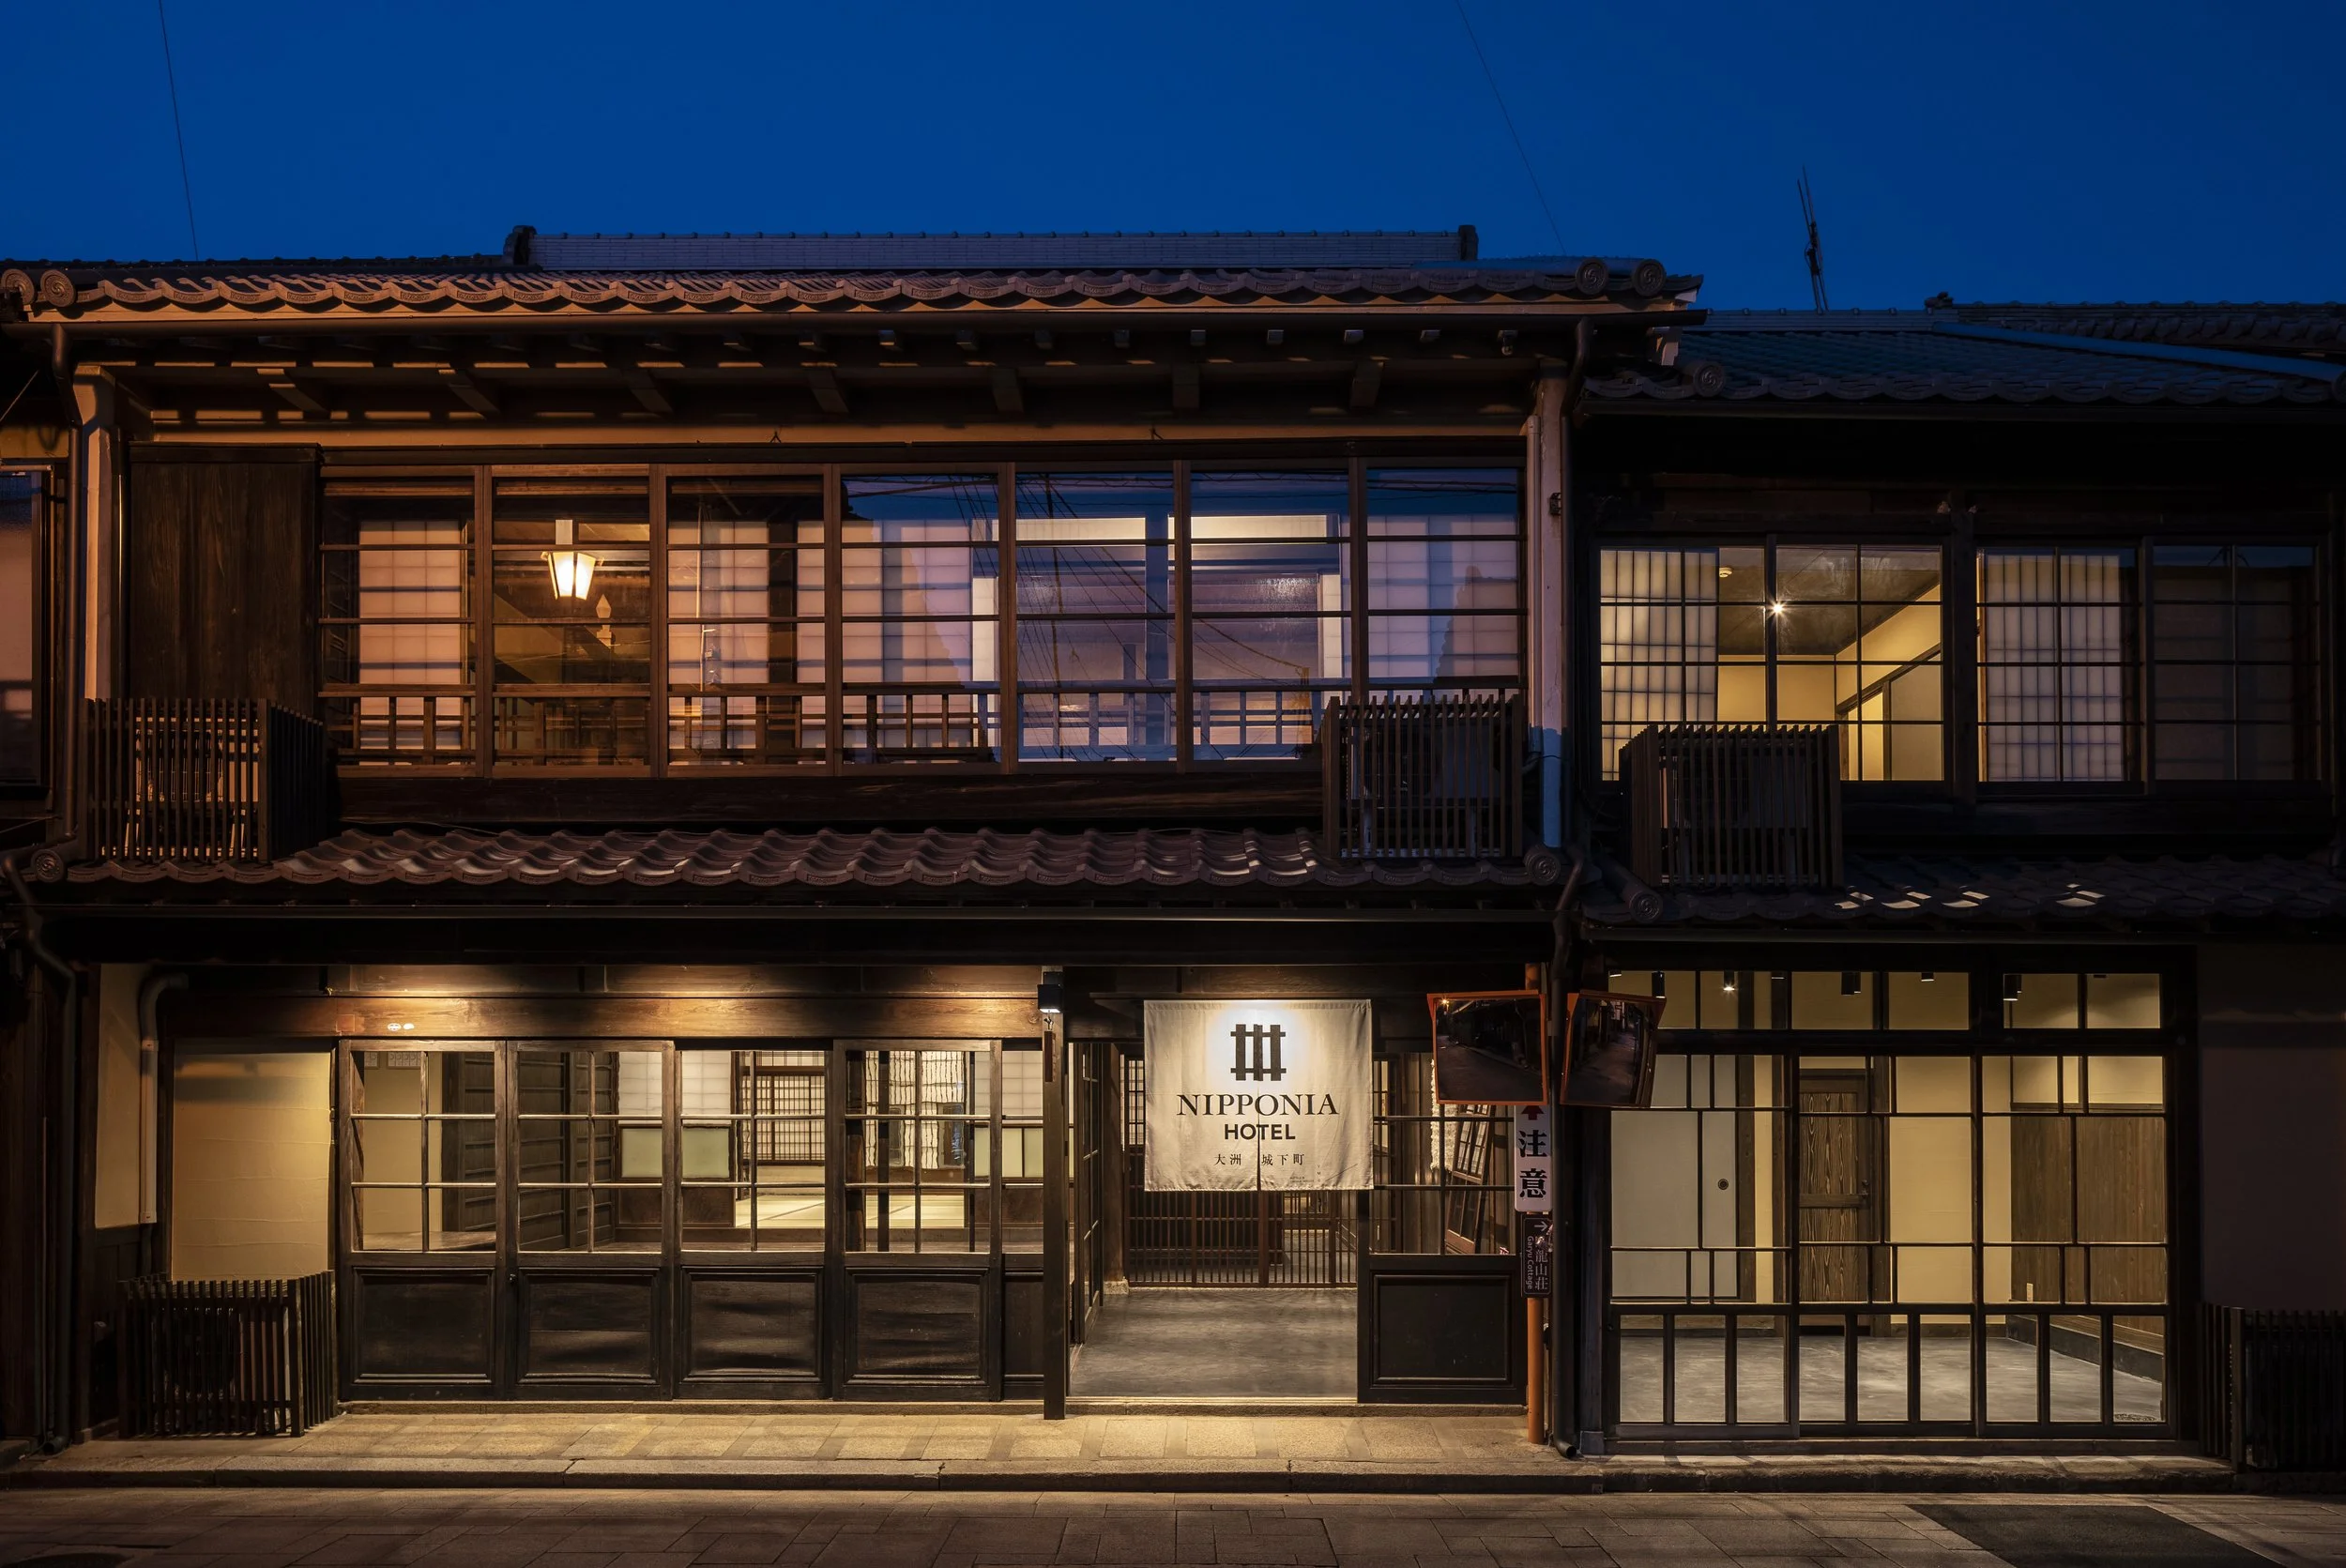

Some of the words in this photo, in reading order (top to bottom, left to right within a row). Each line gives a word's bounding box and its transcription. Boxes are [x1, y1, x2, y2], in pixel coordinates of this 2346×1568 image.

[1176, 1093, 1340, 1117] NIPPONIA
[1224, 1123, 1296, 1140] HOTEL
[1213, 1153, 1242, 1165] 大洲
[1260, 1153, 1304, 1165] 城下町
[1518, 1129, 1547, 1198] 注意
[1526, 1235, 1534, 1258] Garyu
[1525, 1259, 1534, 1290] Cottage
[1535, 1236, 1548, 1290] 龍山荘
